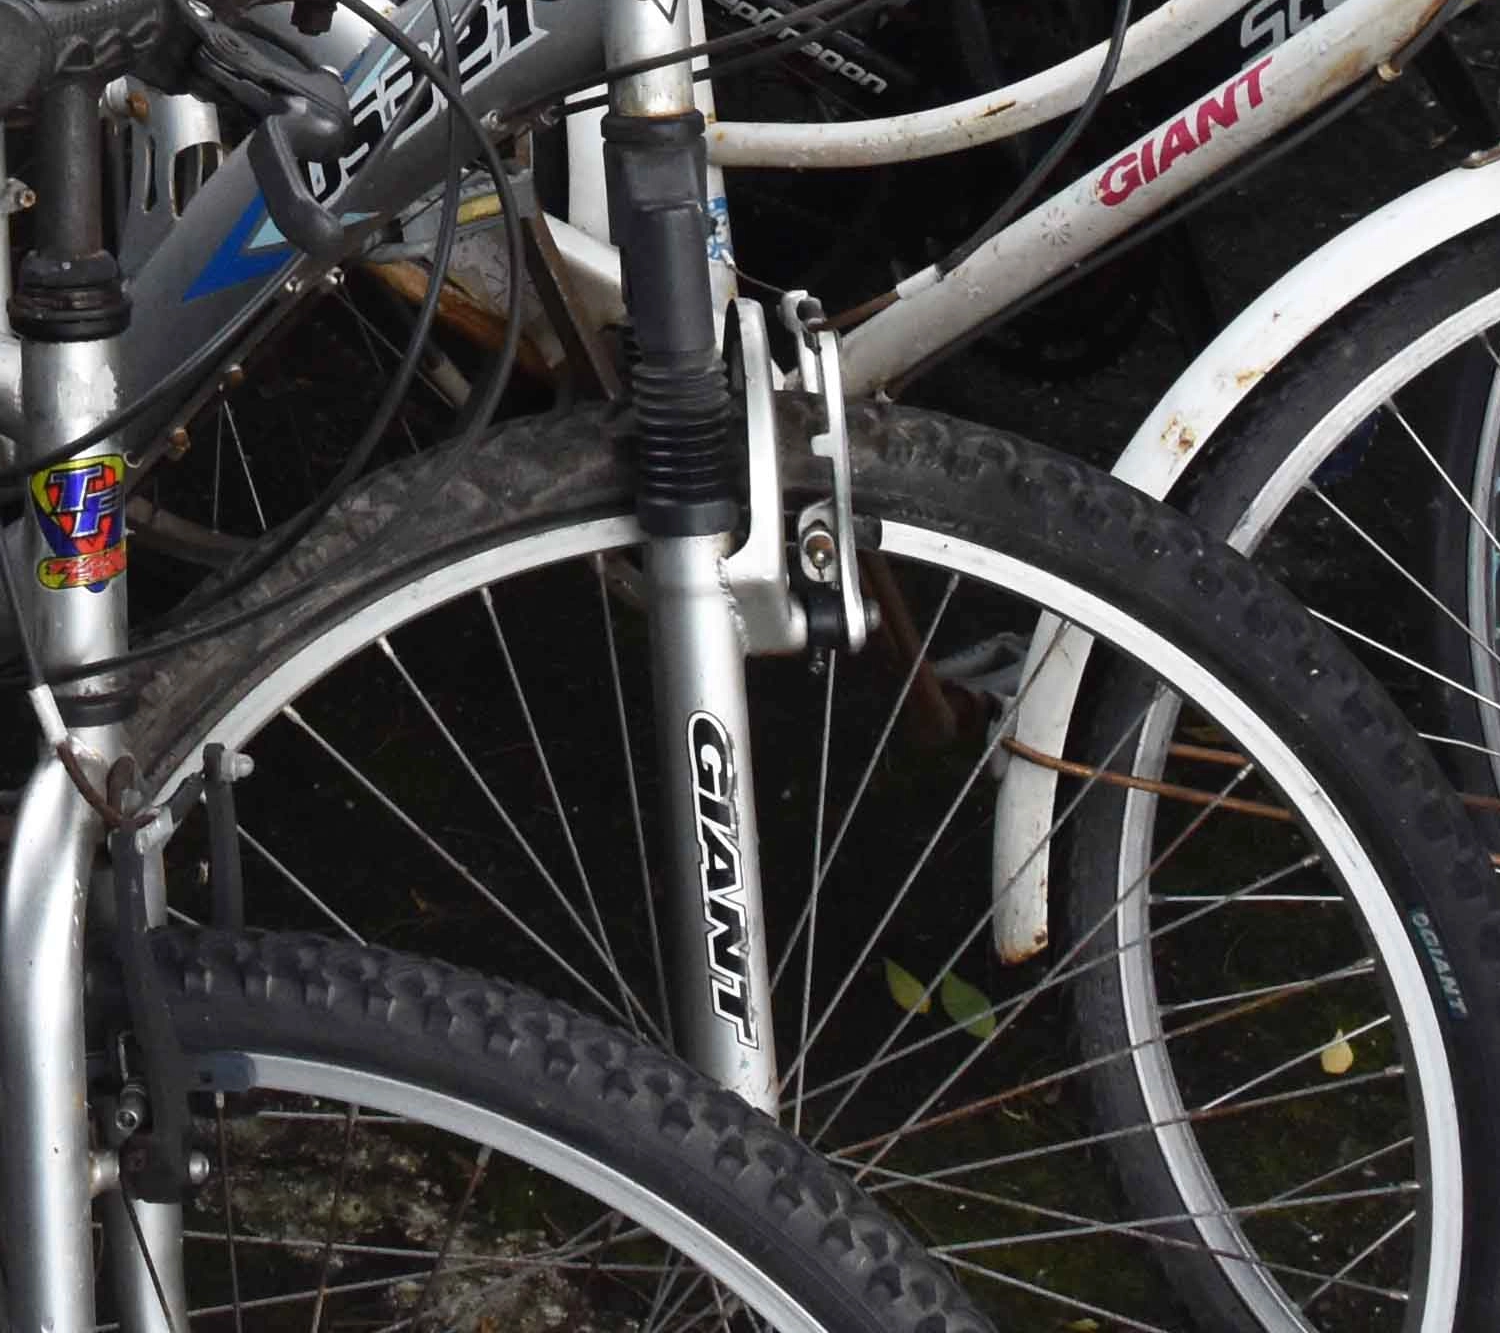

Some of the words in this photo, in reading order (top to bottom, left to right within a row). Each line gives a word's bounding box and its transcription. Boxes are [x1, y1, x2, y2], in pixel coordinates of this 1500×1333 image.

[1097, 55, 1273, 207] GIANT
[685, 709, 761, 1051] GIANT
[1417, 927, 1470, 1017] GIANT
